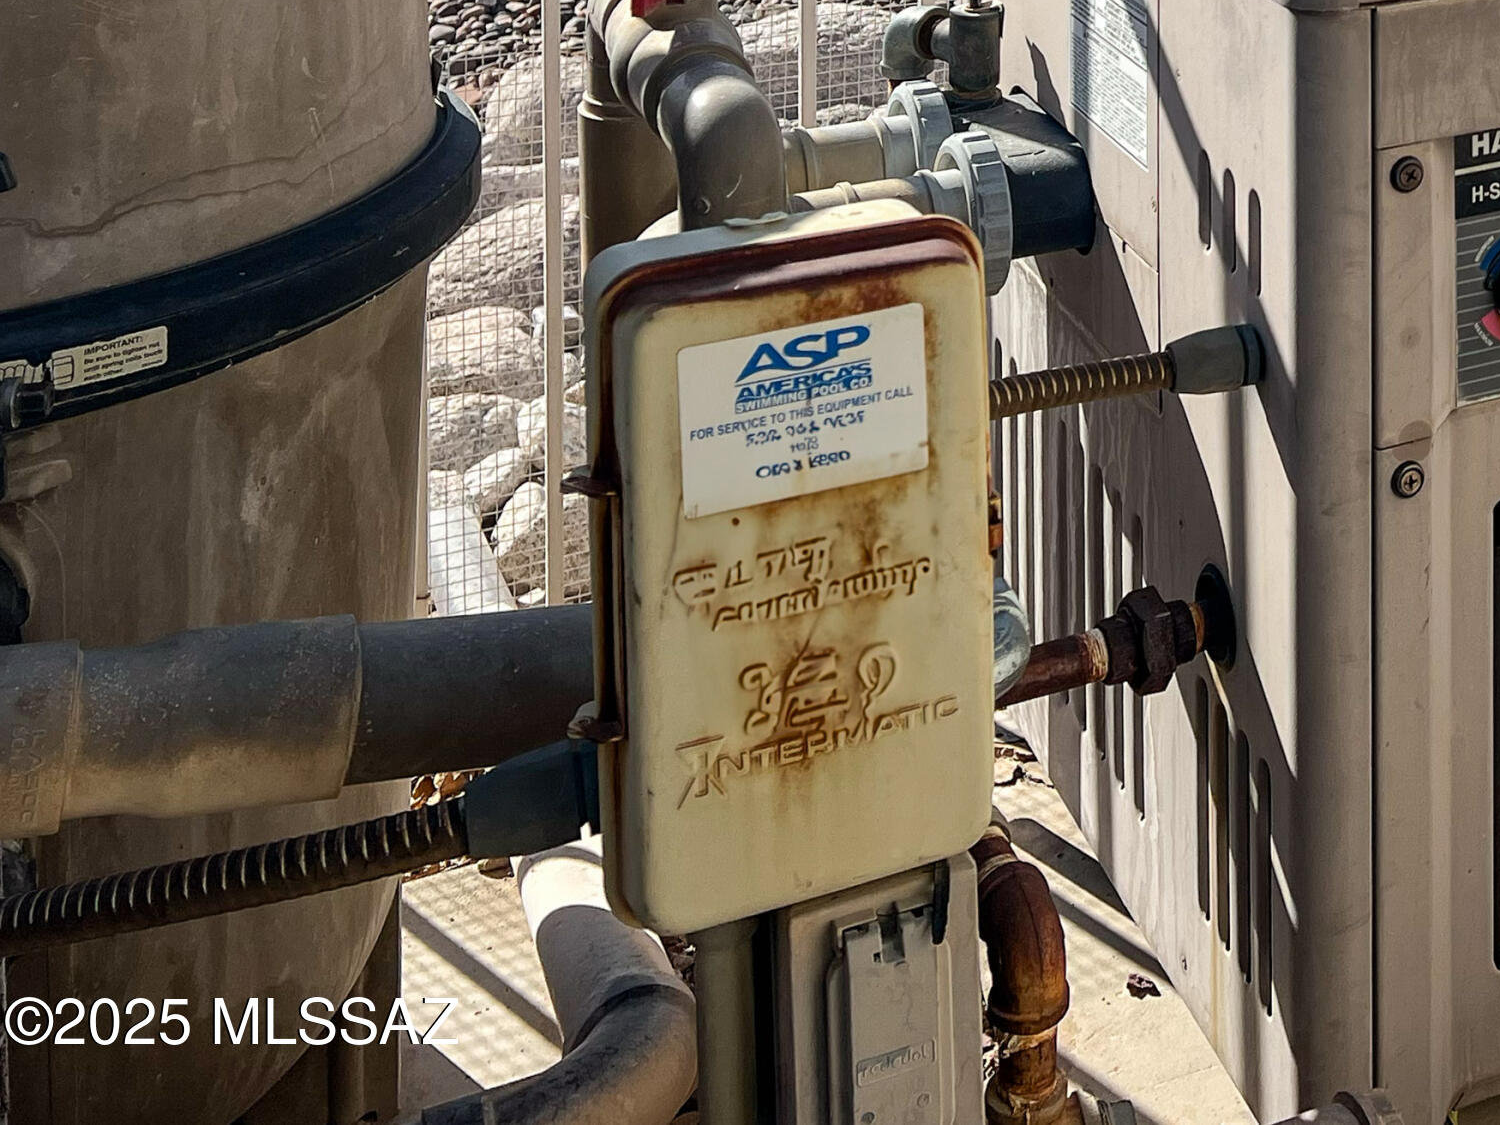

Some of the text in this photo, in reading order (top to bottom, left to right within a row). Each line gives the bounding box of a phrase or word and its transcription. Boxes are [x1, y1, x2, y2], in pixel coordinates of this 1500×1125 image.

[735, 325, 870, 383] ASP
[735, 375, 872, 414] SWIMMING POOL CO.
[736, 363, 872, 401] AMERICA'S
[690, 386, 914, 441] FOR SERVICE TO THIS EQUIPMENT CALL
